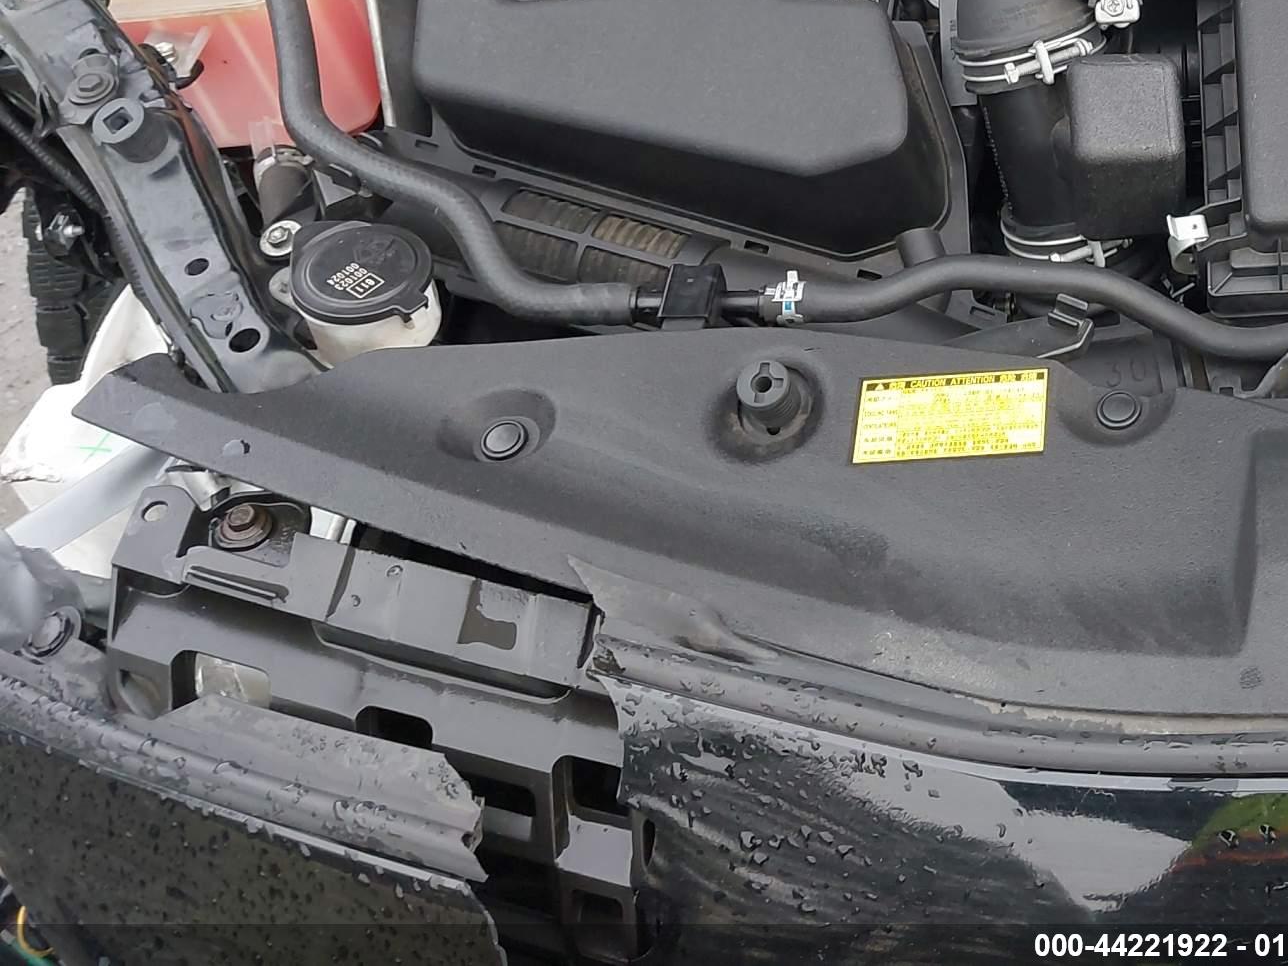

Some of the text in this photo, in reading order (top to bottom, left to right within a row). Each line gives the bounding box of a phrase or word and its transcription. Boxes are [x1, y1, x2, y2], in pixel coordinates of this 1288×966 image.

[334, 268, 367, 291] 001023
[910, 378, 946, 388] CAUTION
[950, 375, 994, 386] ATTENTION
